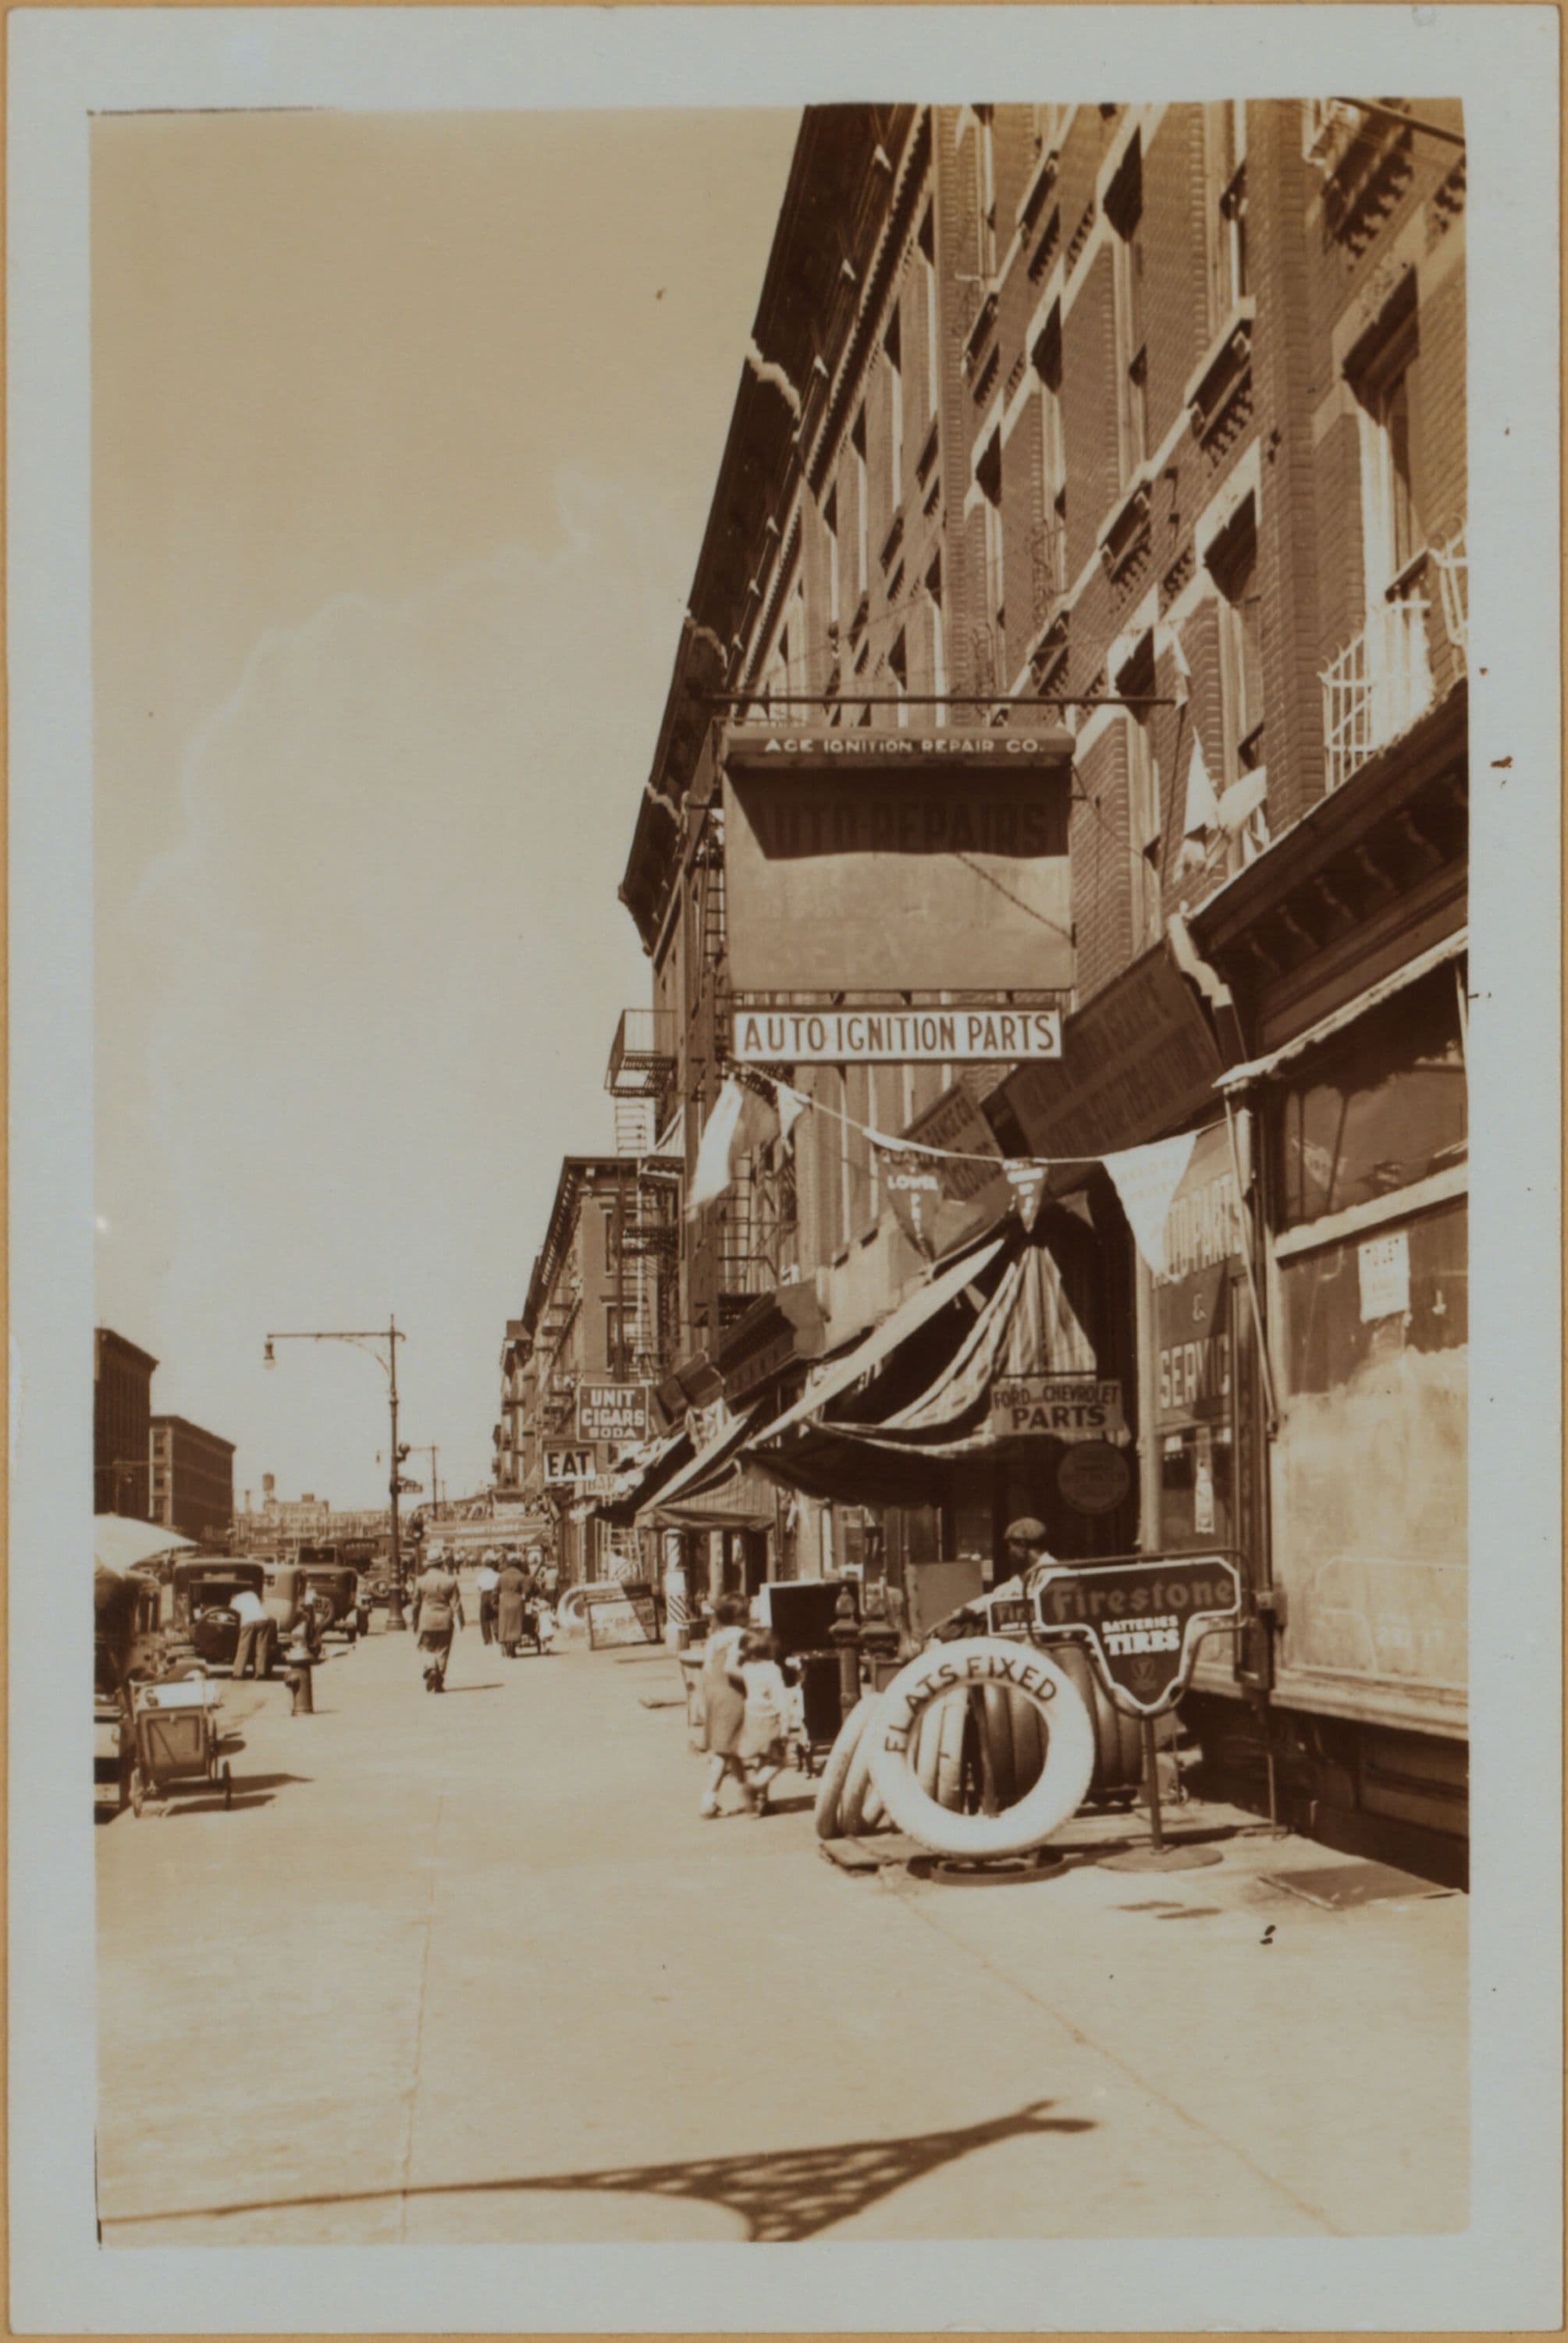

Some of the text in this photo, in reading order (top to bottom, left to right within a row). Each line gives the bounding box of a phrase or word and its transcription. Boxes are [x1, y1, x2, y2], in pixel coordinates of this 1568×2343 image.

[823, 739, 912, 753] IGNITION
[922, 738, 994, 752] REPAIR
[1006, 738, 1044, 752] CO.
[744, 1015, 1055, 1052] AUTO IGNITION PARTS
[591, 1388, 636, 1407] UNIT
[993, 1385, 1119, 1409] FORD CHEVROLET
[581, 1408, 645, 1427] CIGARS
[1011, 1405, 1107, 1430] PARTS
[588, 1427, 637, 1438] SODA
[547, 1451, 591, 1477] EAT
[1052, 1579, 1234, 1622] Firestone
[1102, 1615, 1179, 1634] BATTERIES
[1104, 1628, 1180, 1656] TIRES
[884, 1655, 1058, 1753] FLATS FIXED
